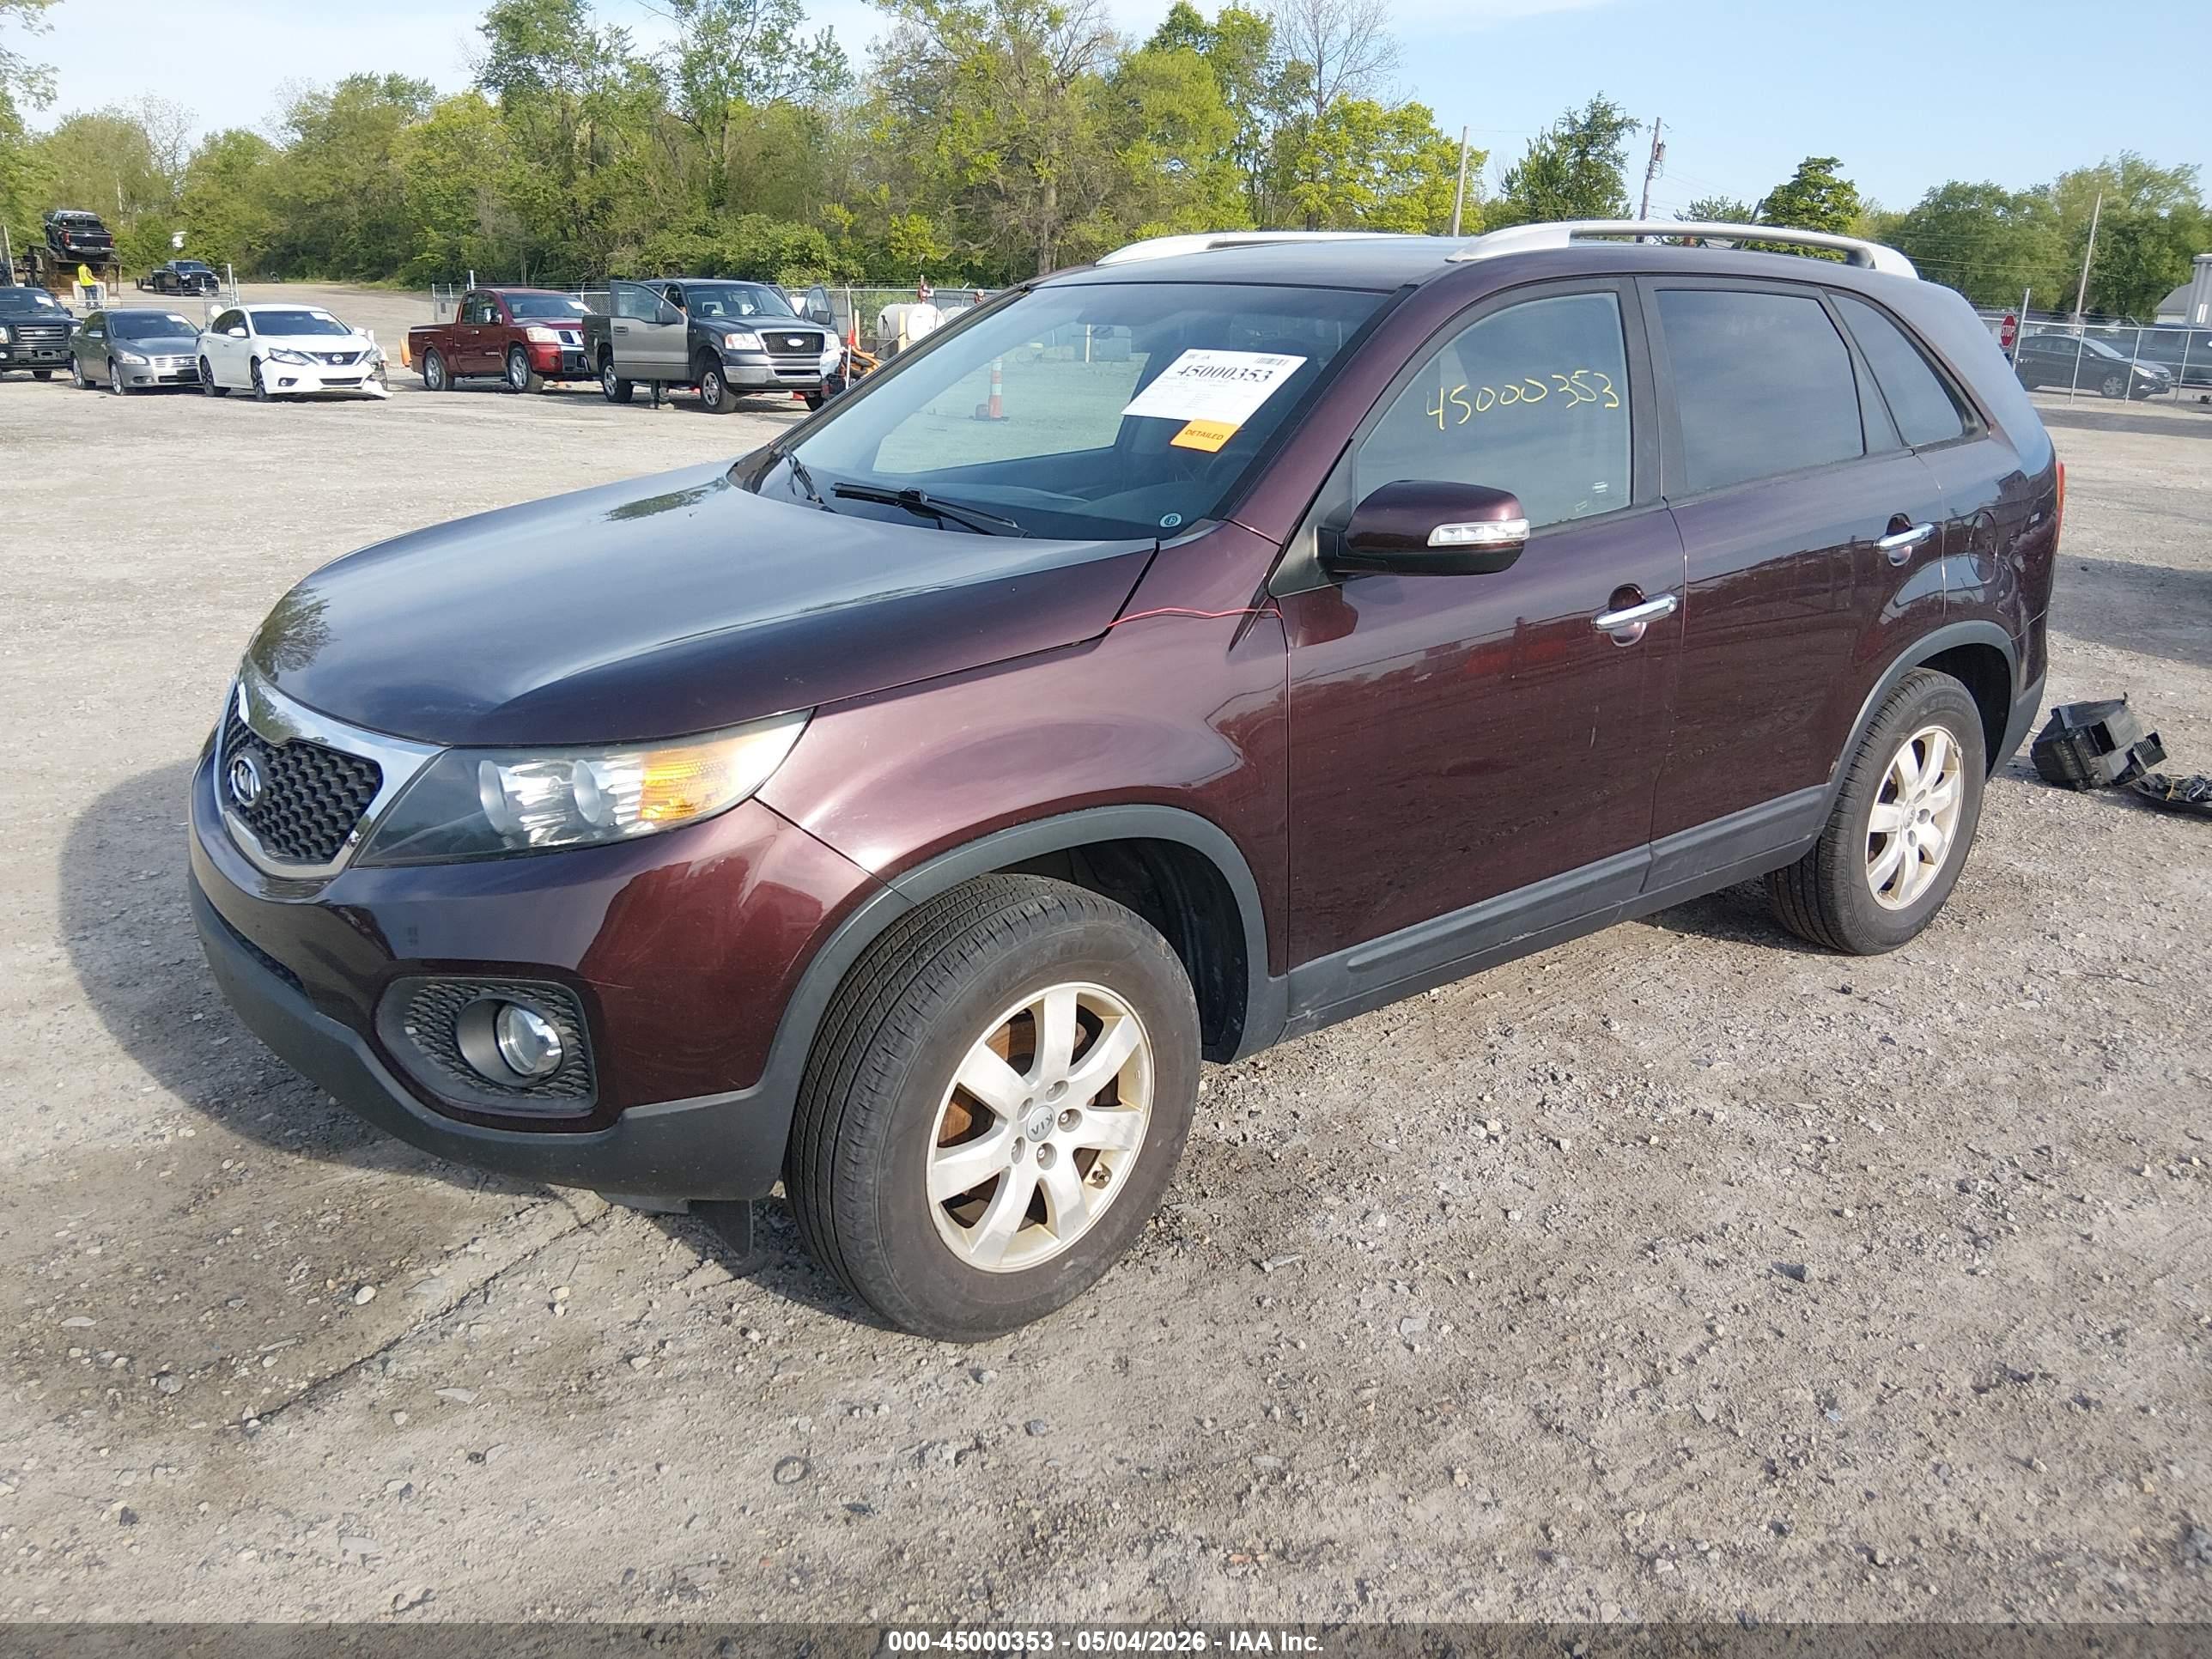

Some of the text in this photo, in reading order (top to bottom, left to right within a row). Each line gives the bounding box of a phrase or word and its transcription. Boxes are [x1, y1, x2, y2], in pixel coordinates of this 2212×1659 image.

[2001, 325, 2014, 337] STOP
[1177, 364, 1273, 383] 45000353
[1425, 369, 1620, 431] 45000353
[1184, 428, 1224, 441] DETAILED
[1030, 1112, 1054, 1135] KIA
